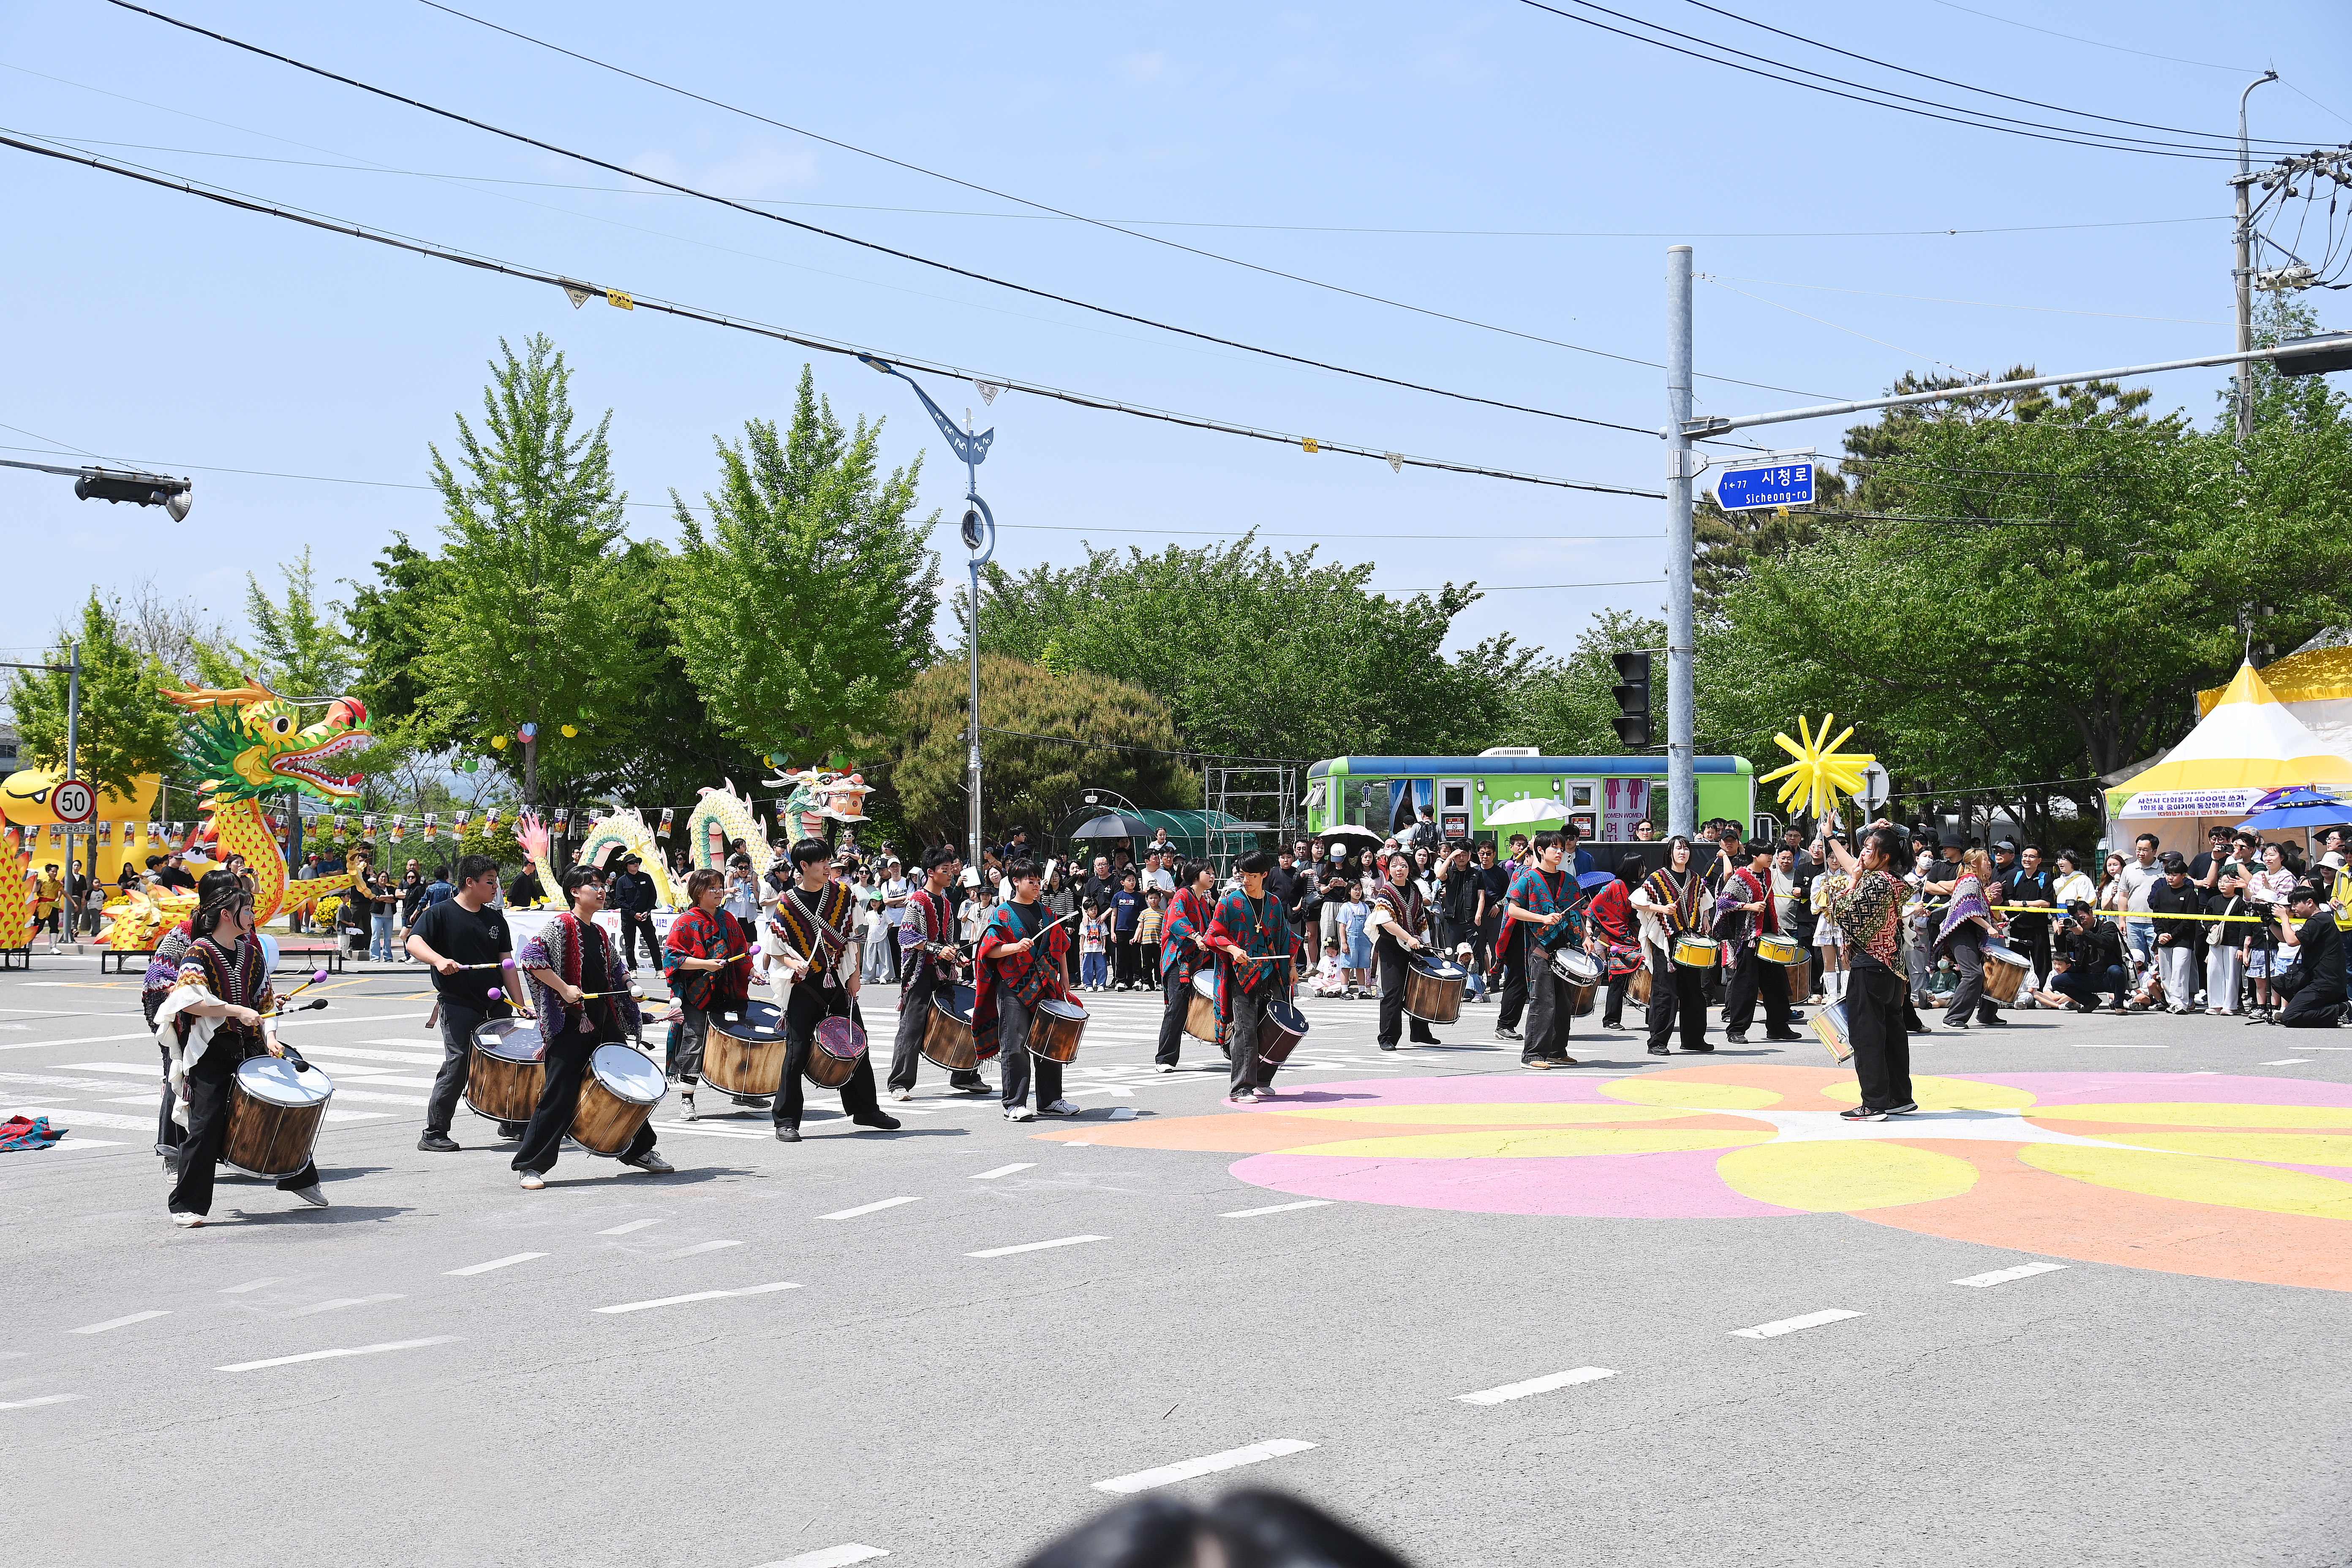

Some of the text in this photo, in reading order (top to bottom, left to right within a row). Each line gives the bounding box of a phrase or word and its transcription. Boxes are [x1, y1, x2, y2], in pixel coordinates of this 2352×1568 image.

[1761, 467, 1808, 486] 시청로
[1746, 490, 1807, 504] Sicheong-ro
[62, 792, 84, 811] 50
[607, 917, 618, 928] Fly
[656, 919, 667, 928] 사천
